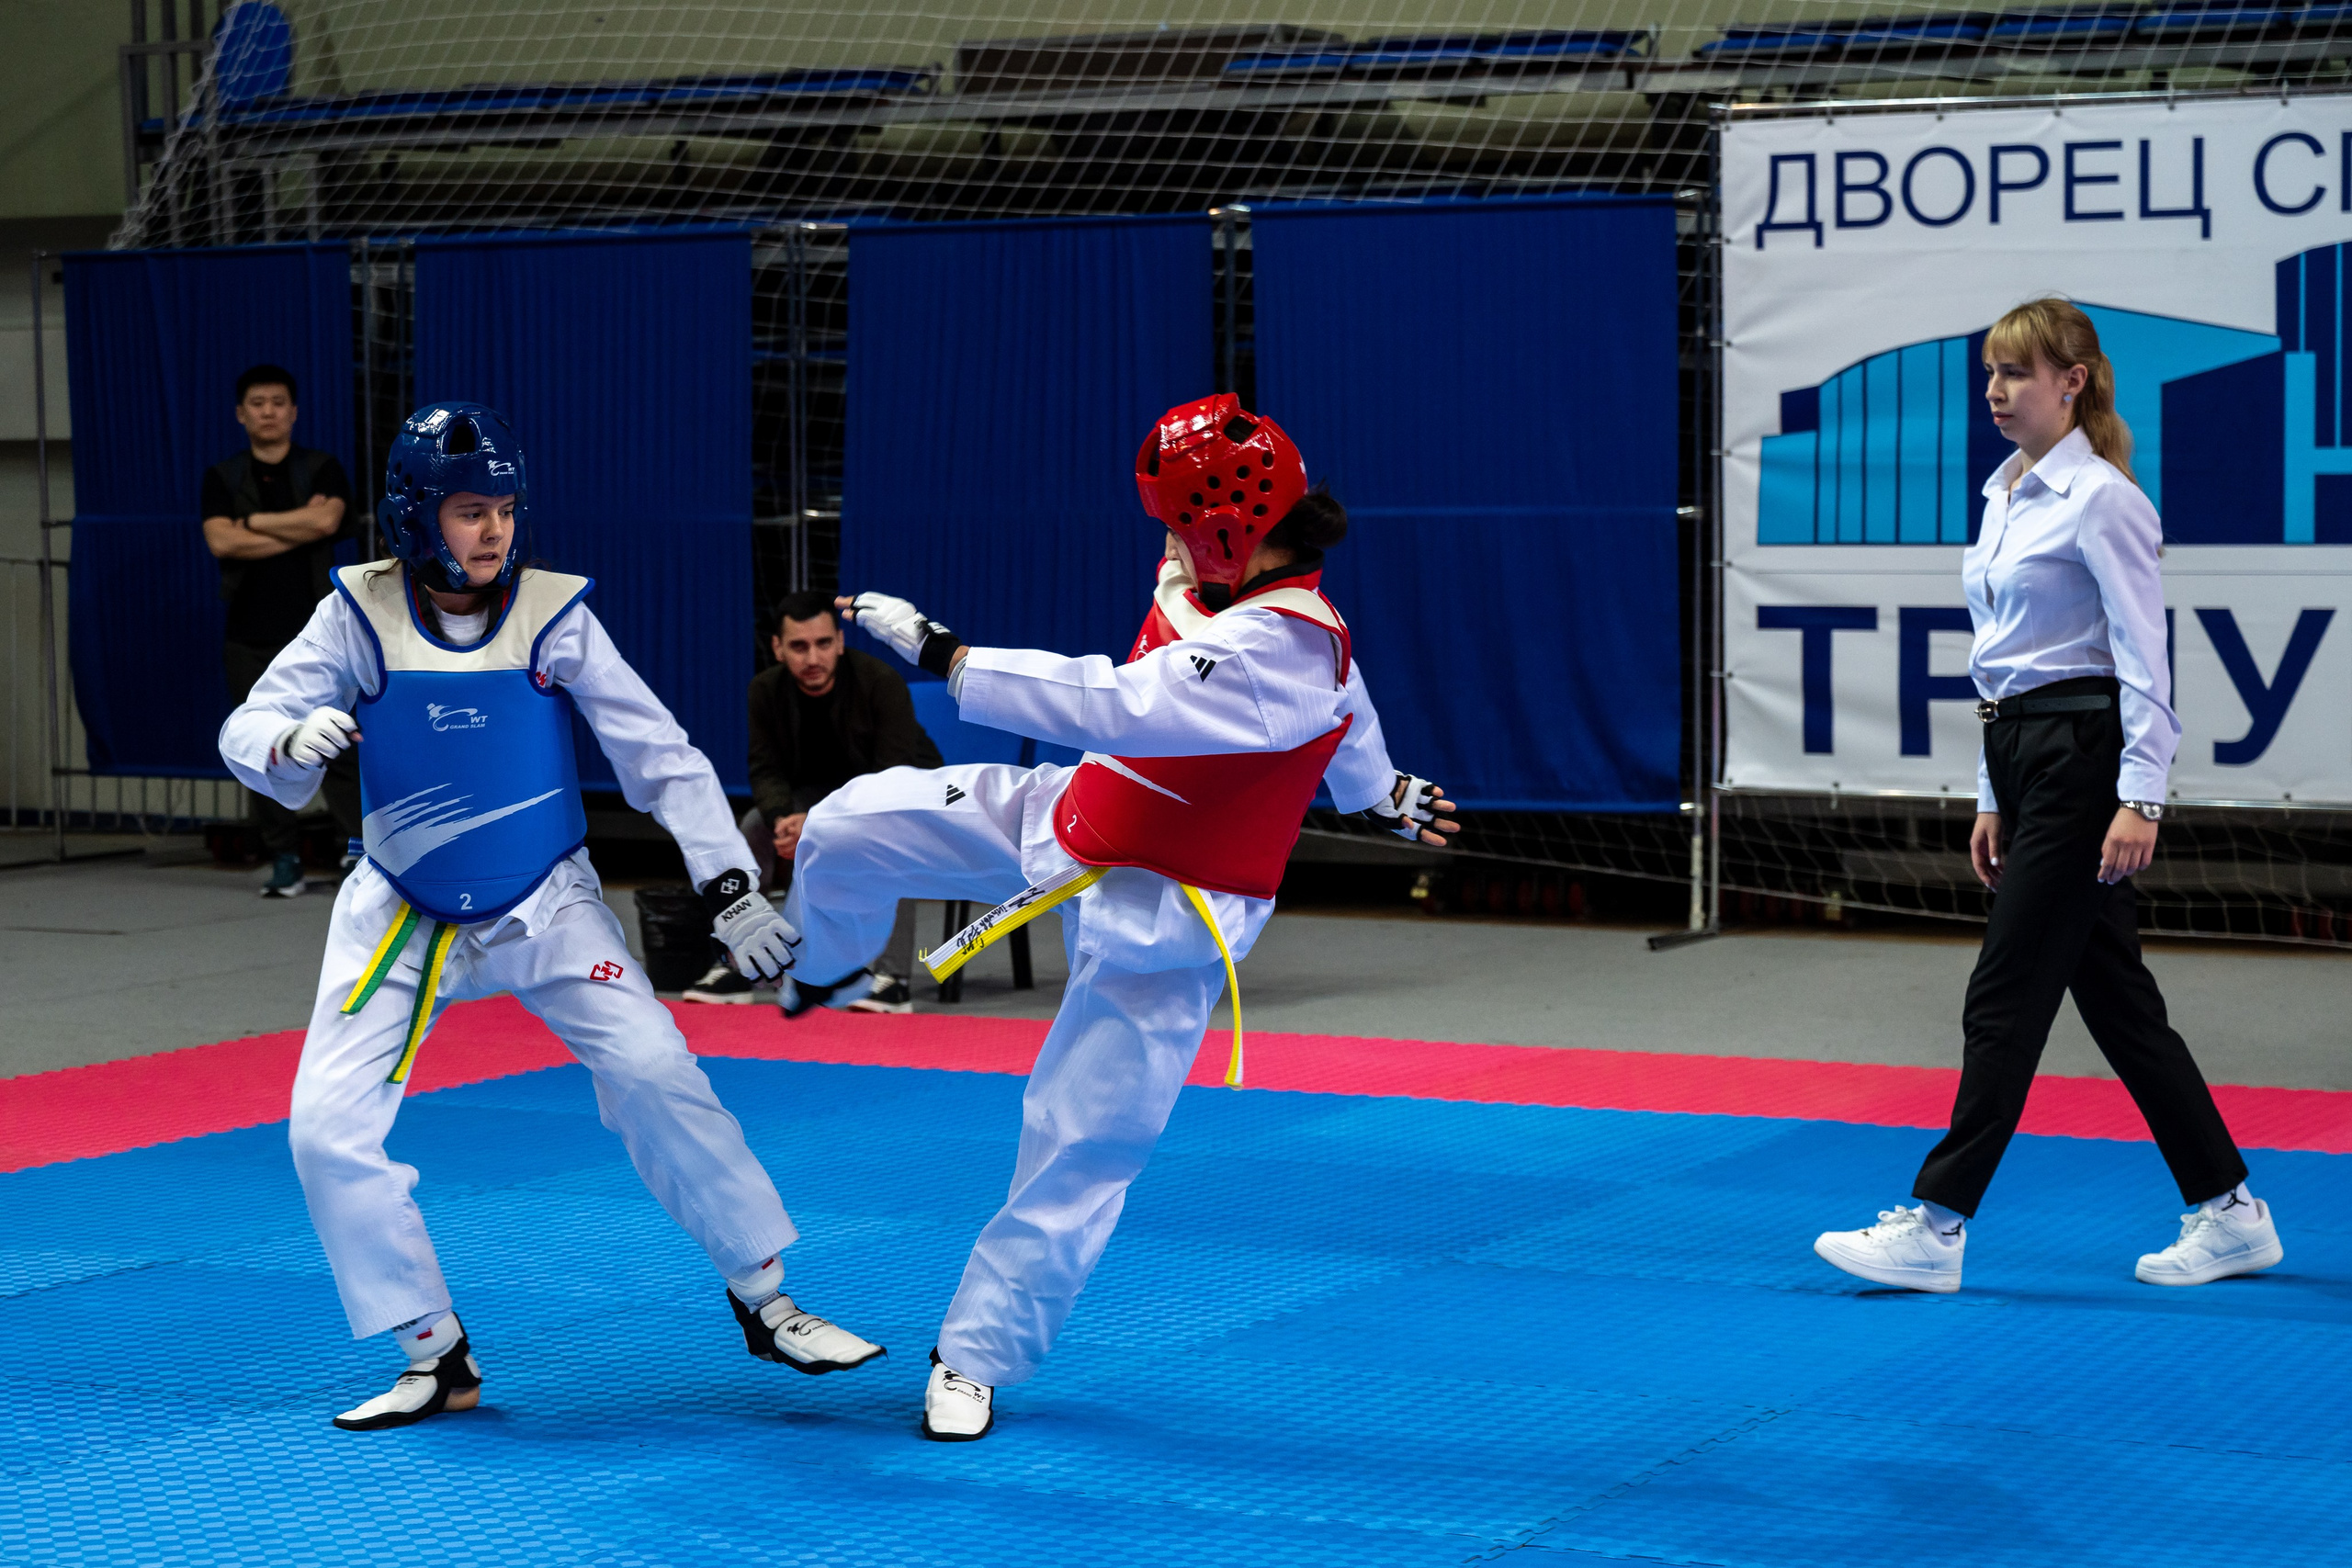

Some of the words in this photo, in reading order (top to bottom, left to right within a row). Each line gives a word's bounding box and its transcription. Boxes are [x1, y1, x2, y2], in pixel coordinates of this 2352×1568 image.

[1755, 137, 2211, 250] ДВОРЕЦ
[1756, 604, 2337, 766] ТРУ
[470, 715, 489, 724] WT
[1067, 814, 1078, 834] 2
[459, 893, 473, 910] 2
[720, 899, 752, 923] KHAN
[974, 1392, 987, 1401] WT
